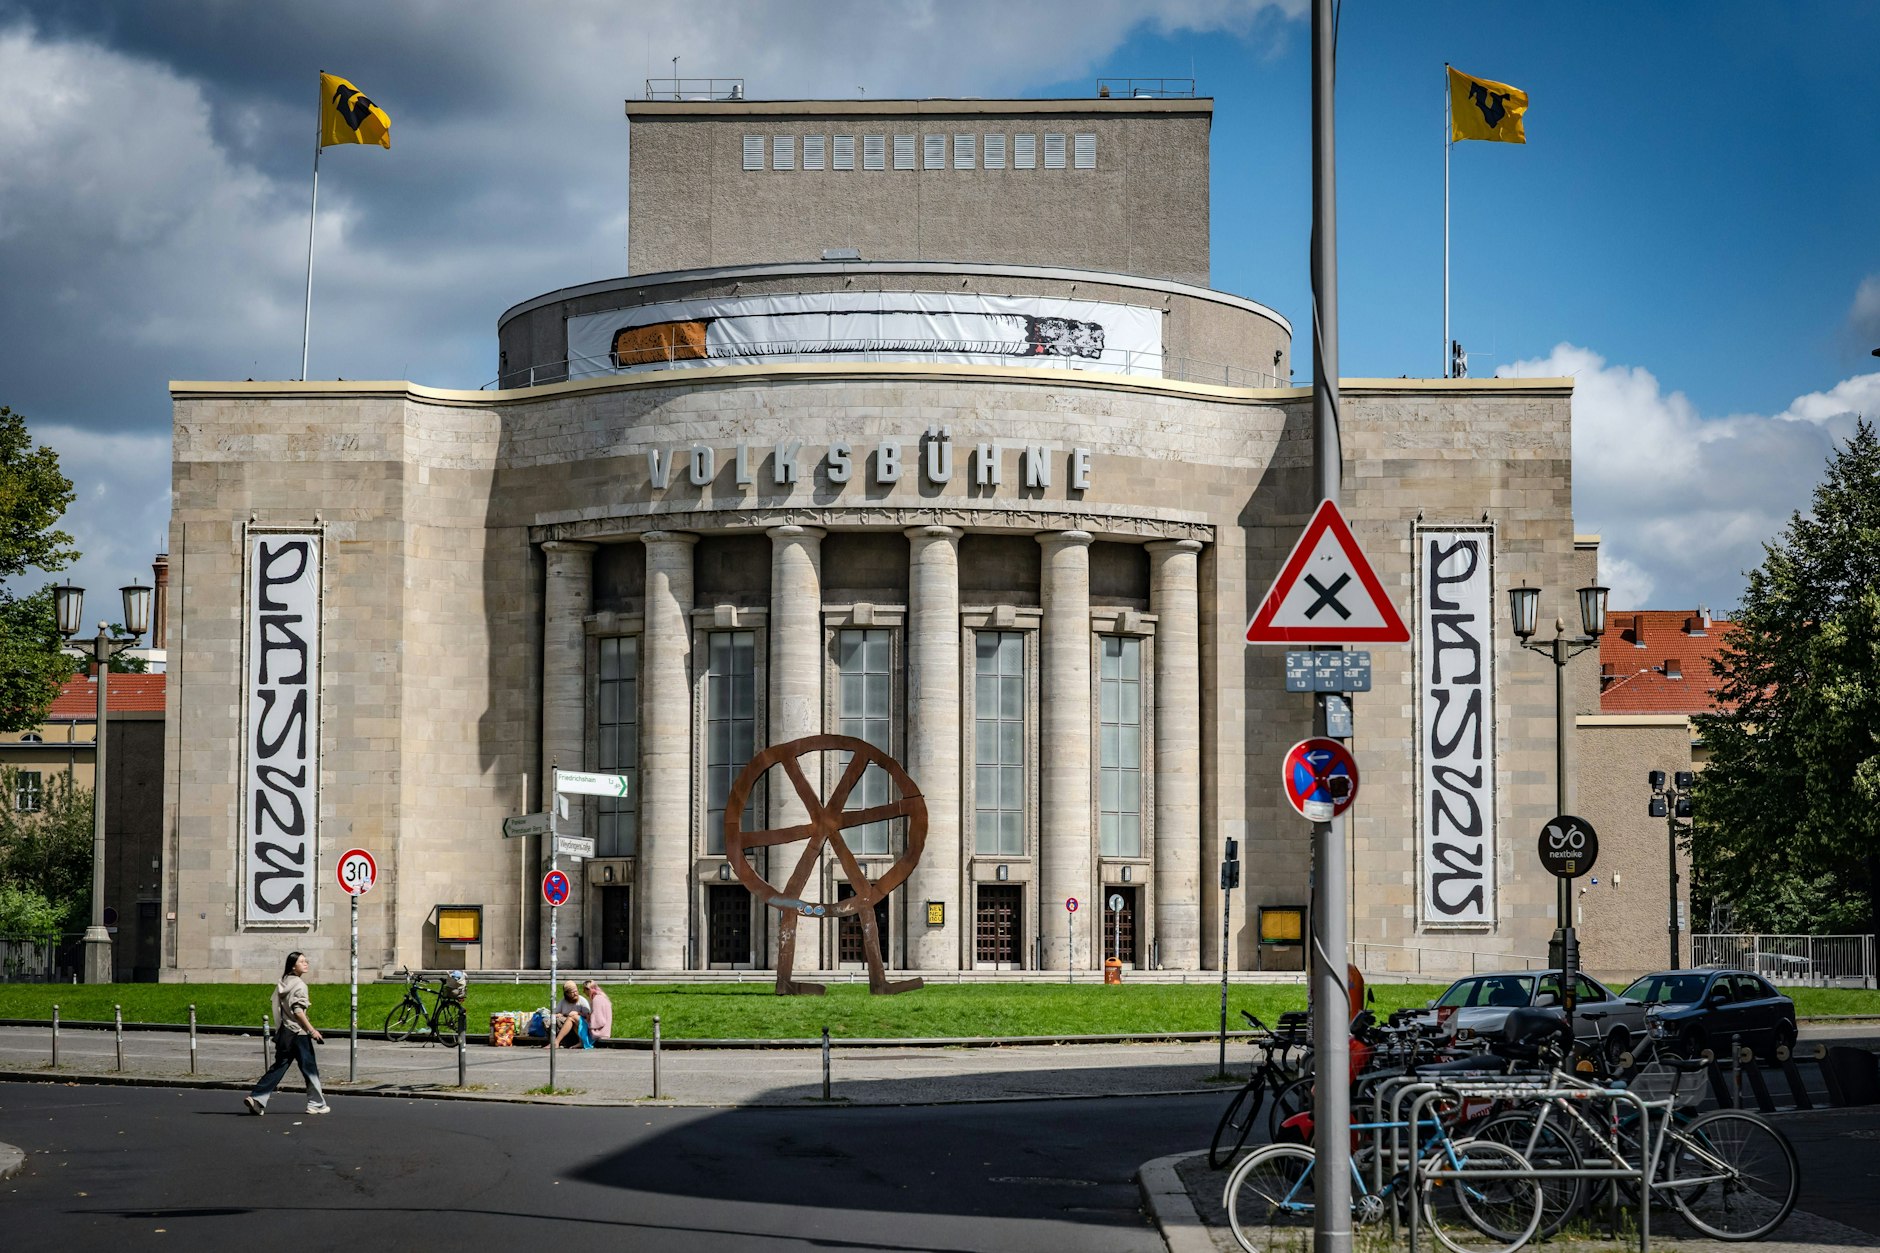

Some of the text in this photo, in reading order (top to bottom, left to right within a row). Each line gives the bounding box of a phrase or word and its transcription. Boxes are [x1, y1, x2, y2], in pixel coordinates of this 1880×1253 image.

[646, 425, 1091, 490] VOLKSBÜHNE
[1287, 657, 1294, 666] S
[1315, 657, 1322, 666] K
[1343, 657, 1351, 666] S
[1328, 702, 1334, 712] S
[558, 773, 597, 783] Friedrichshain
[1549, 850, 1583, 858] nextbike
[346, 862, 368, 882] 30
